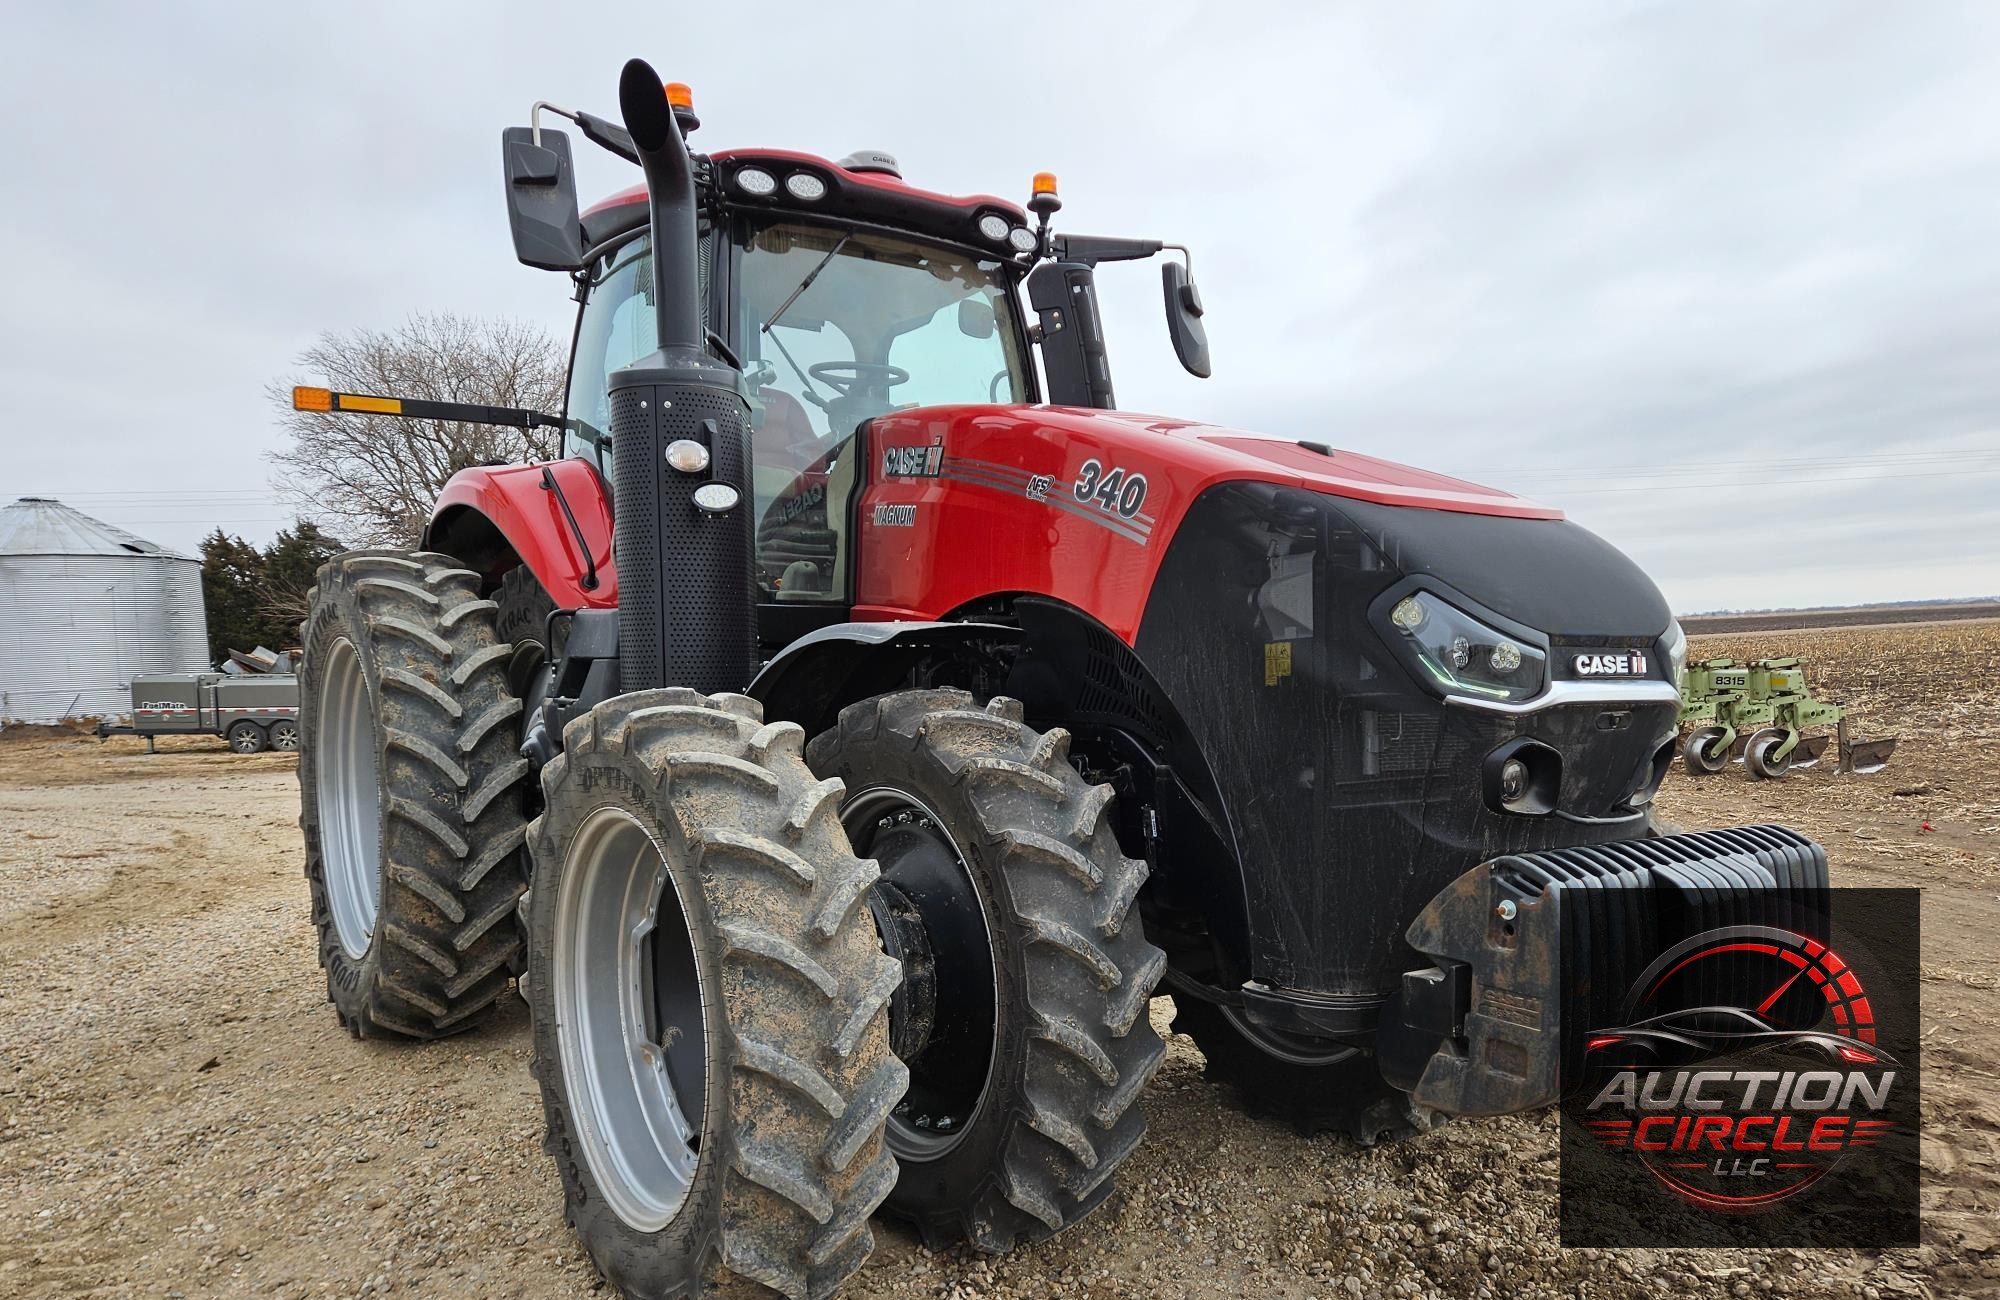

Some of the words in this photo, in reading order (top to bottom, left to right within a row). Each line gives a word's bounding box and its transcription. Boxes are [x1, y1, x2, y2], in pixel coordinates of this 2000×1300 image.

[884, 446, 927, 475] CASE
[1027, 474, 1051, 493] AFS
[1074, 458, 1148, 519] 340
[873, 504, 917, 527] MAGNUM
[1576, 655, 1629, 674] CASE
[1715, 676, 1746, 686] 8315
[141, 701, 185, 710] FuelMate
